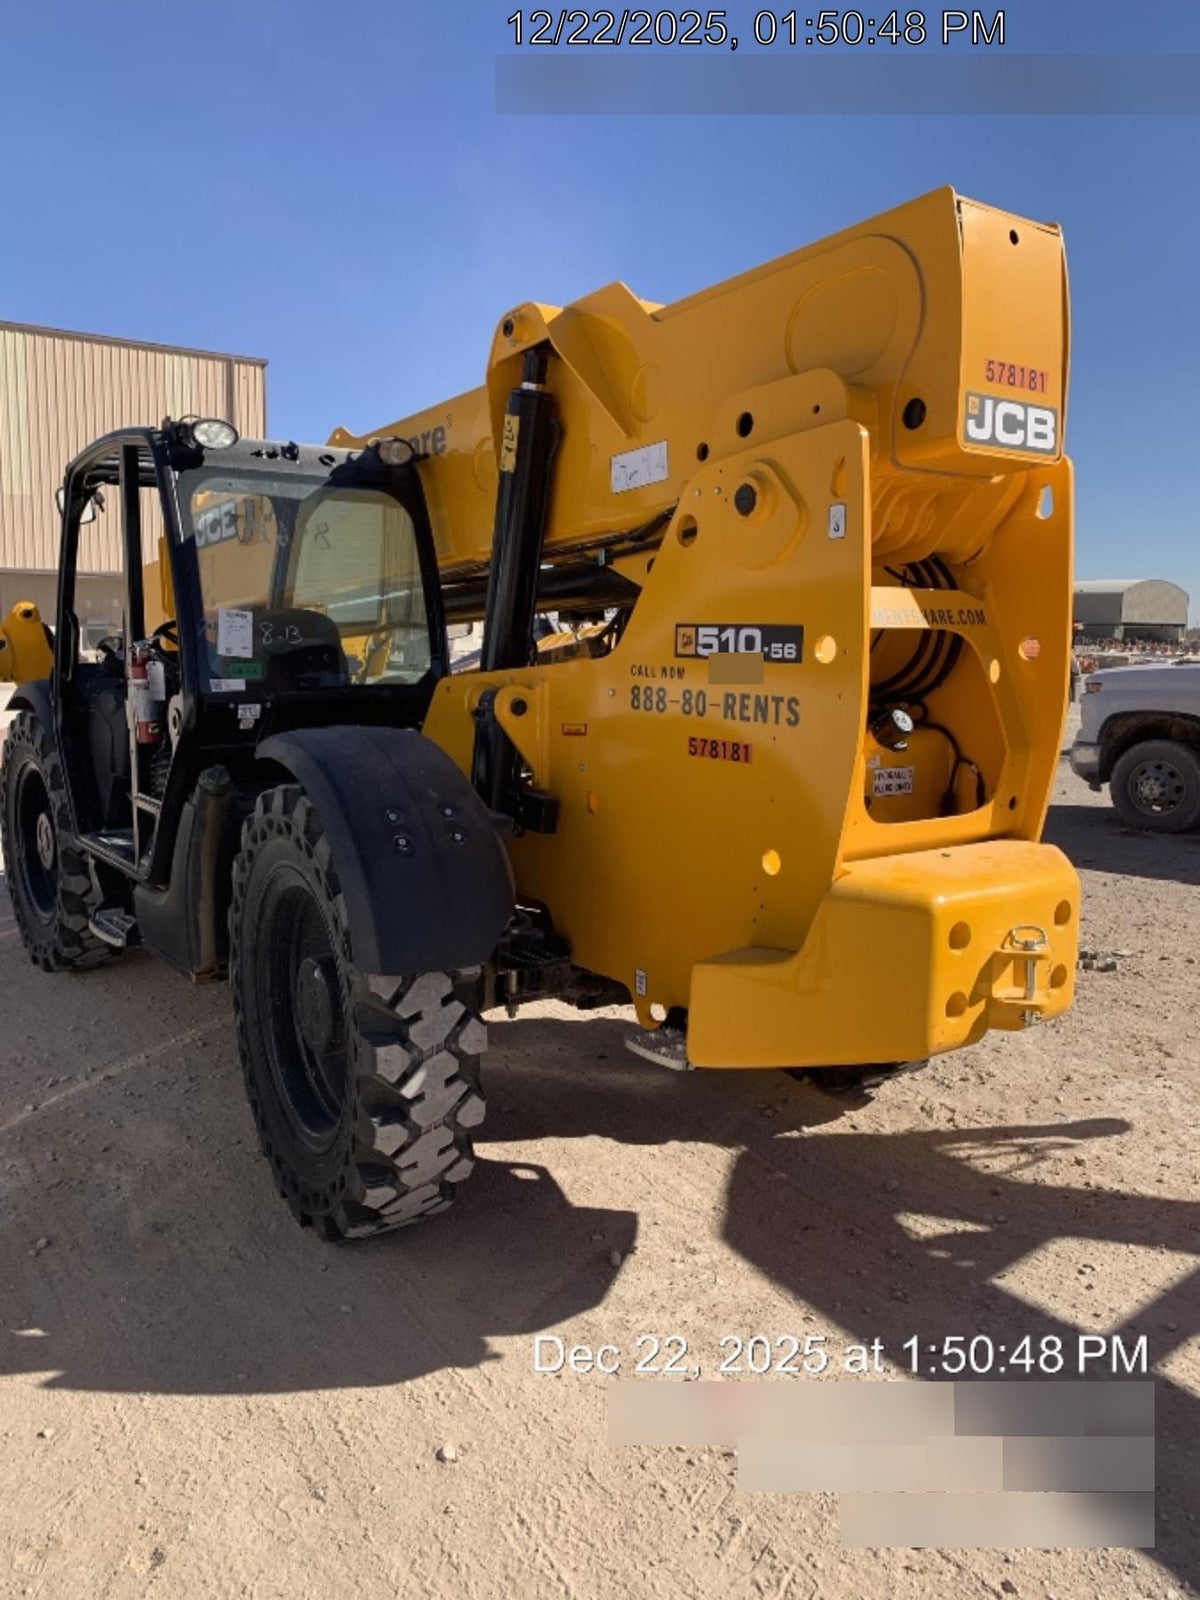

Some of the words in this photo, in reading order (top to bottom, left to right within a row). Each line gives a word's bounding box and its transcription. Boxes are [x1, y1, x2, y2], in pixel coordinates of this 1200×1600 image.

[985, 360, 1046, 393] 578181
[966, 398, 1056, 450] JCB
[630, 664, 657, 678] CALL
[661, 666, 686, 680] NOW
[630, 684, 801, 727] 888-80-RENTS
[688, 736, 752, 764] 578181
